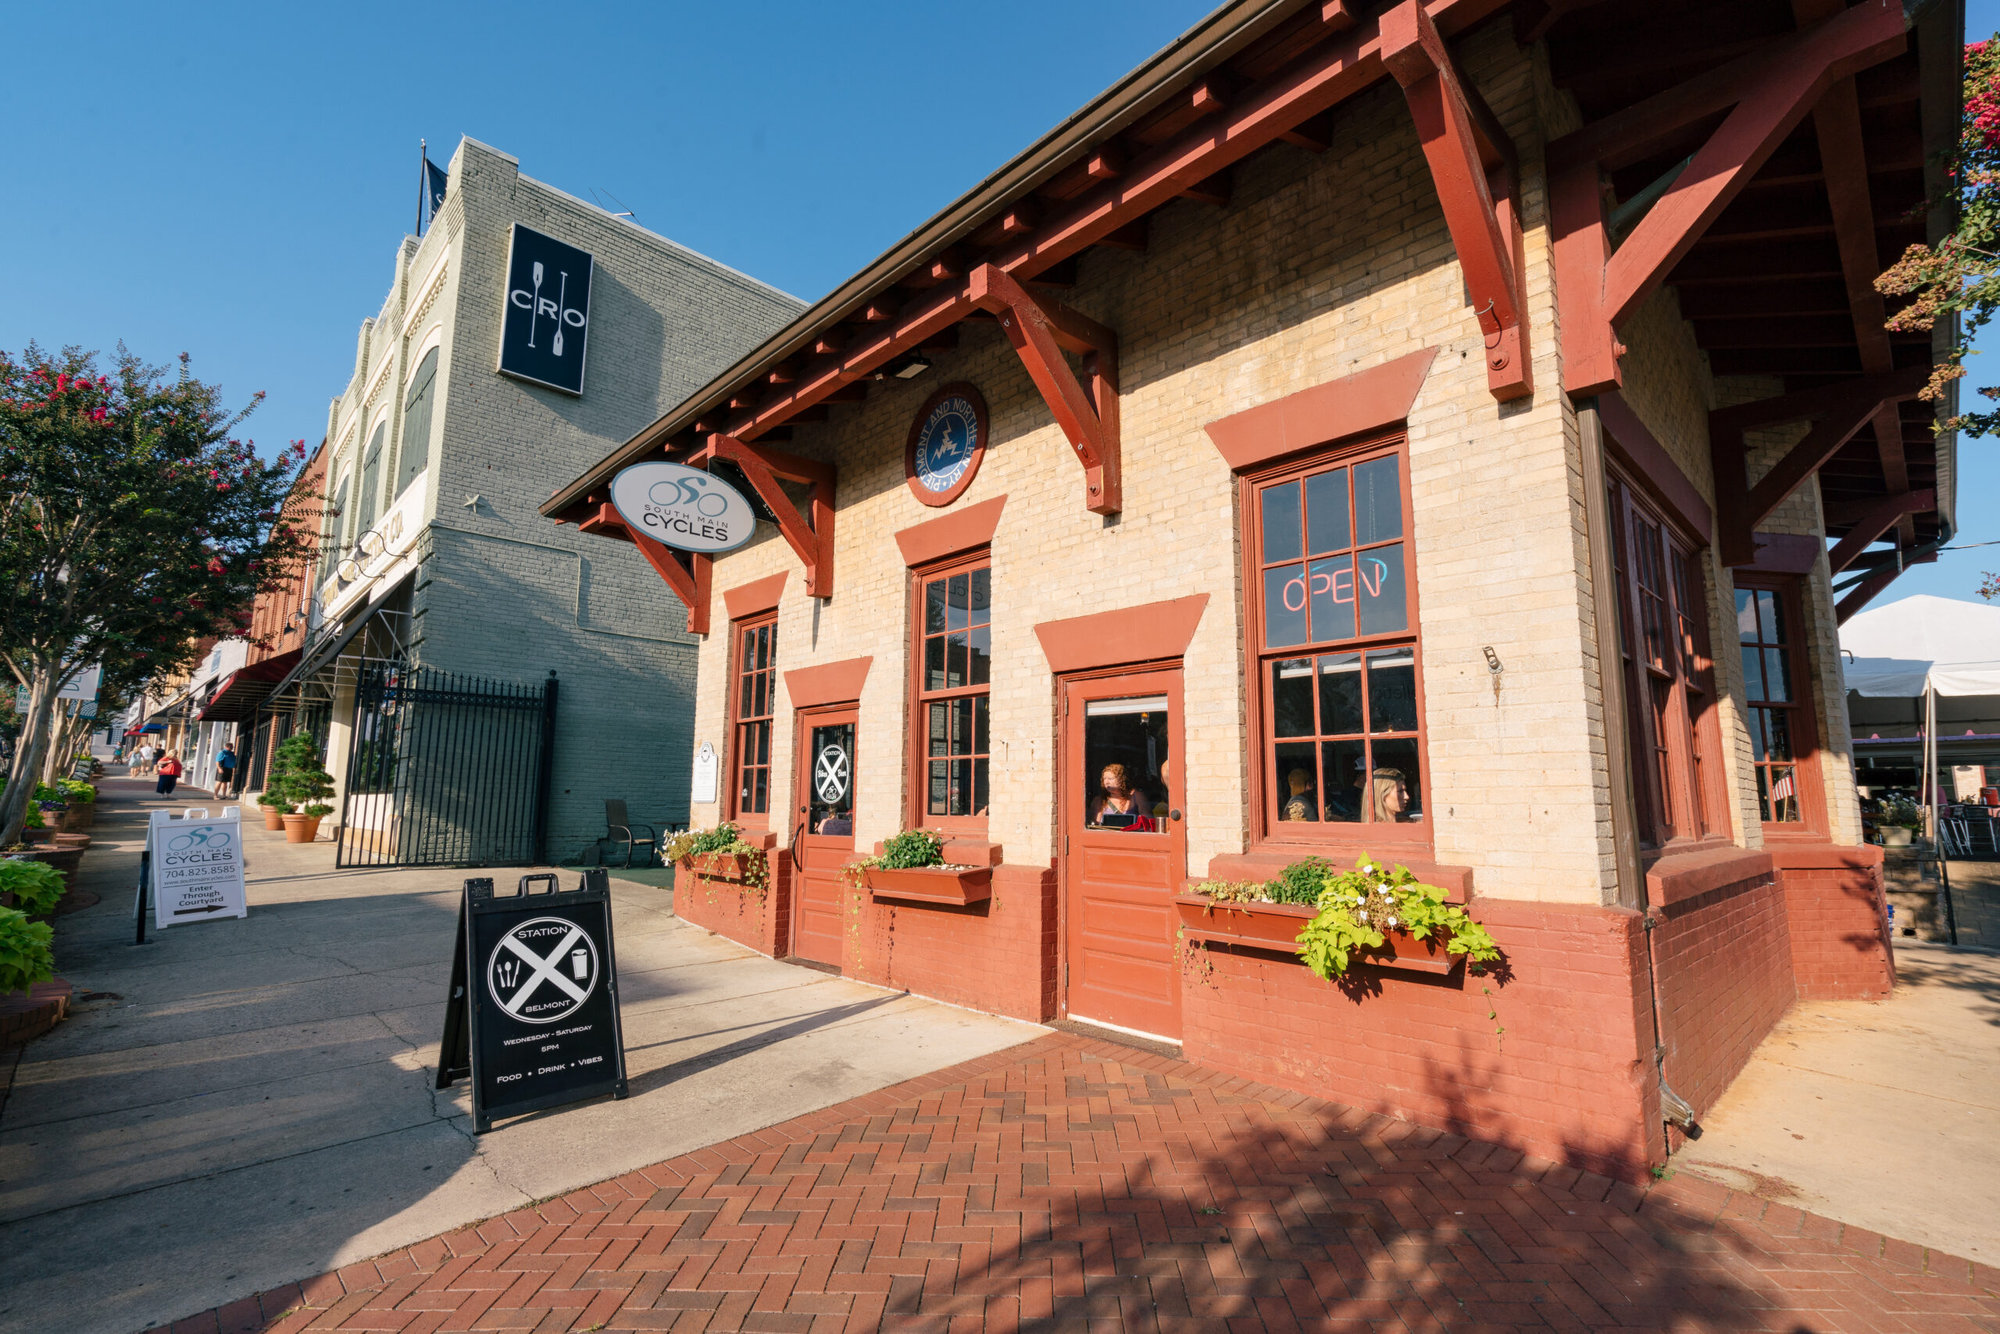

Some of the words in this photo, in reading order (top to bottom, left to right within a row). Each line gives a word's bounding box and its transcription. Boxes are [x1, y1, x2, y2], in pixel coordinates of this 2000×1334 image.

[931, 401, 950, 424] AND
[954, 398, 978, 468] NORTHERN
[644, 504, 690, 519] SOUTH
[698, 516, 729, 528] MAIN
[643, 512, 728, 542] CYCLES
[1283, 563, 1380, 612] OPEN
[166, 852, 232, 865] CYCLES
[165, 865, 236, 878] 704.825.8585
[178, 896, 224, 907] Courtyard
[183, 890, 220, 900] Through
[518, 926, 568, 938] STATION
[526, 1000, 570, 1013] BELMONT
[497, 1073, 522, 1084] FOOD
[538, 1064, 566, 1075] DRINK
[578, 1056, 603, 1066] VIBES
